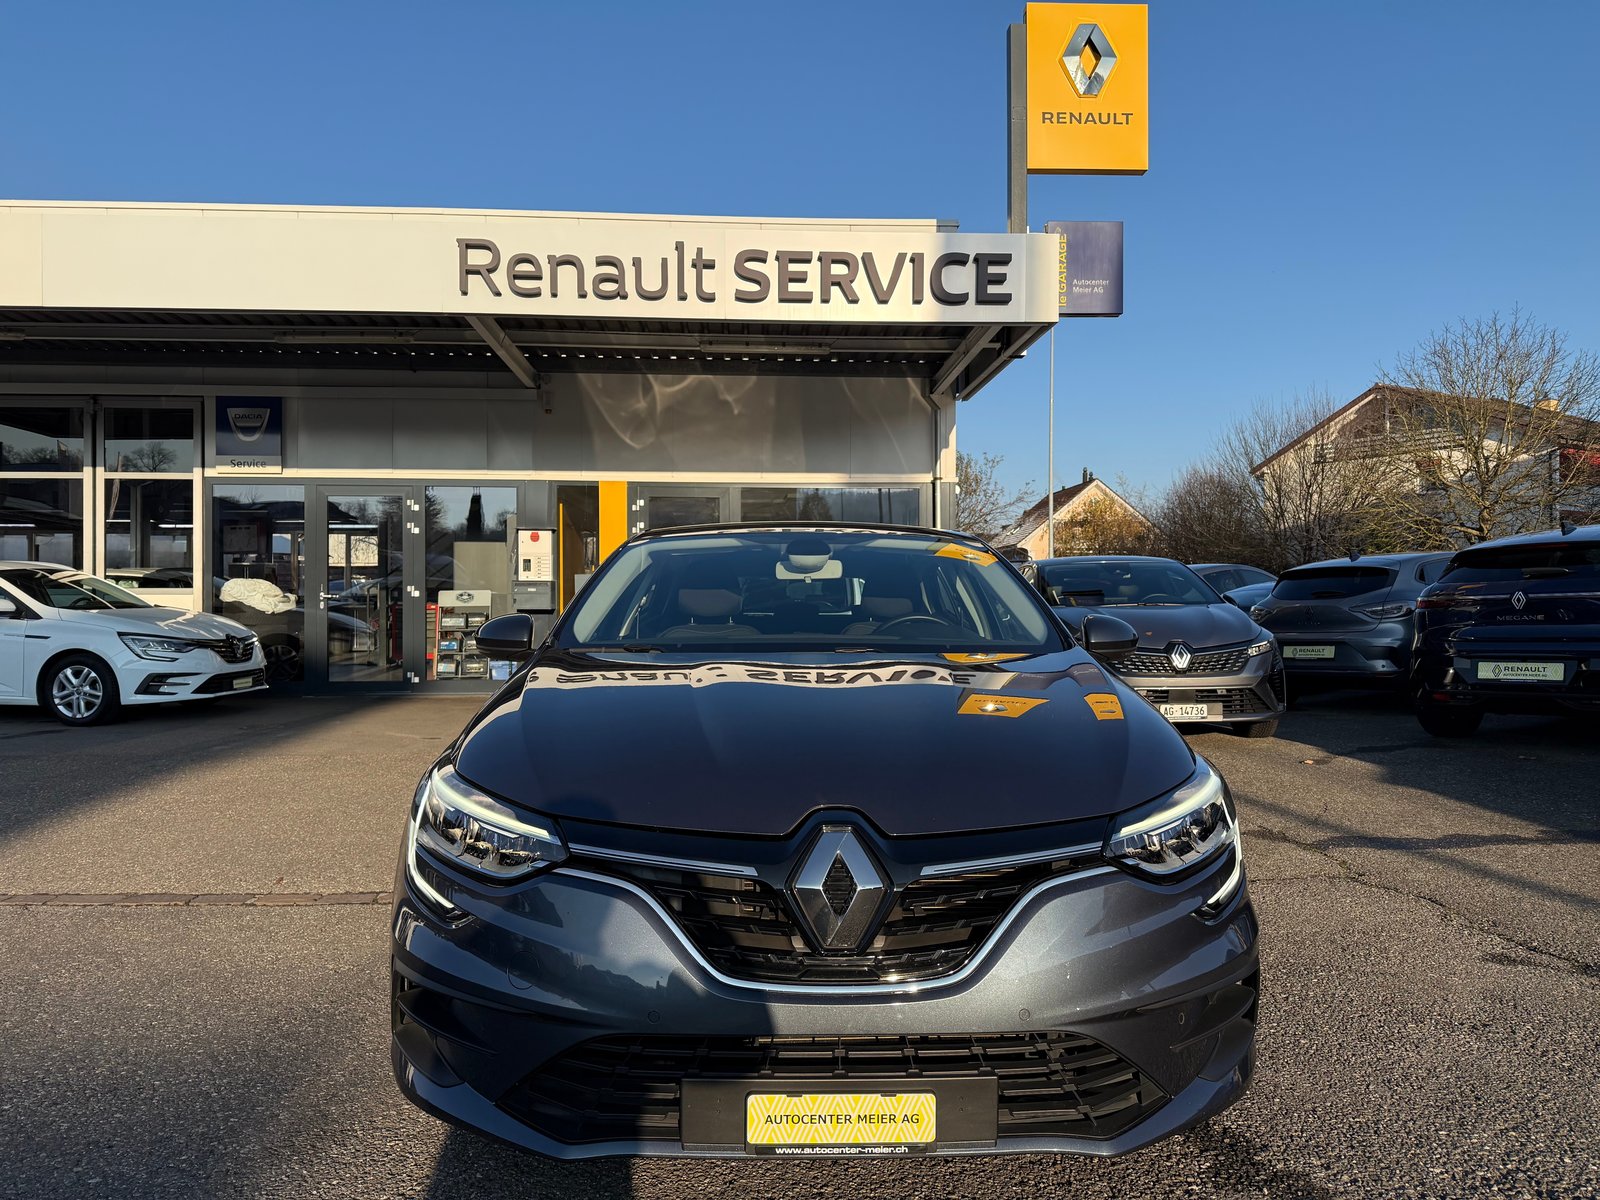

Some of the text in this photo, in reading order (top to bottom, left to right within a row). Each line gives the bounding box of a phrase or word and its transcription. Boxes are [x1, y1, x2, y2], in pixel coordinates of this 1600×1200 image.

[1041, 111, 1134, 125] RENAULT
[1059, 233, 1067, 293] GARAGE
[456, 238, 1013, 306] Renault SERVICE
[230, 459, 267, 468] Service
[765, 1113, 919, 1125] AUTOCENTER MEIER AG
[775, 1146, 909, 1154] www.autocenter-meier.ch
